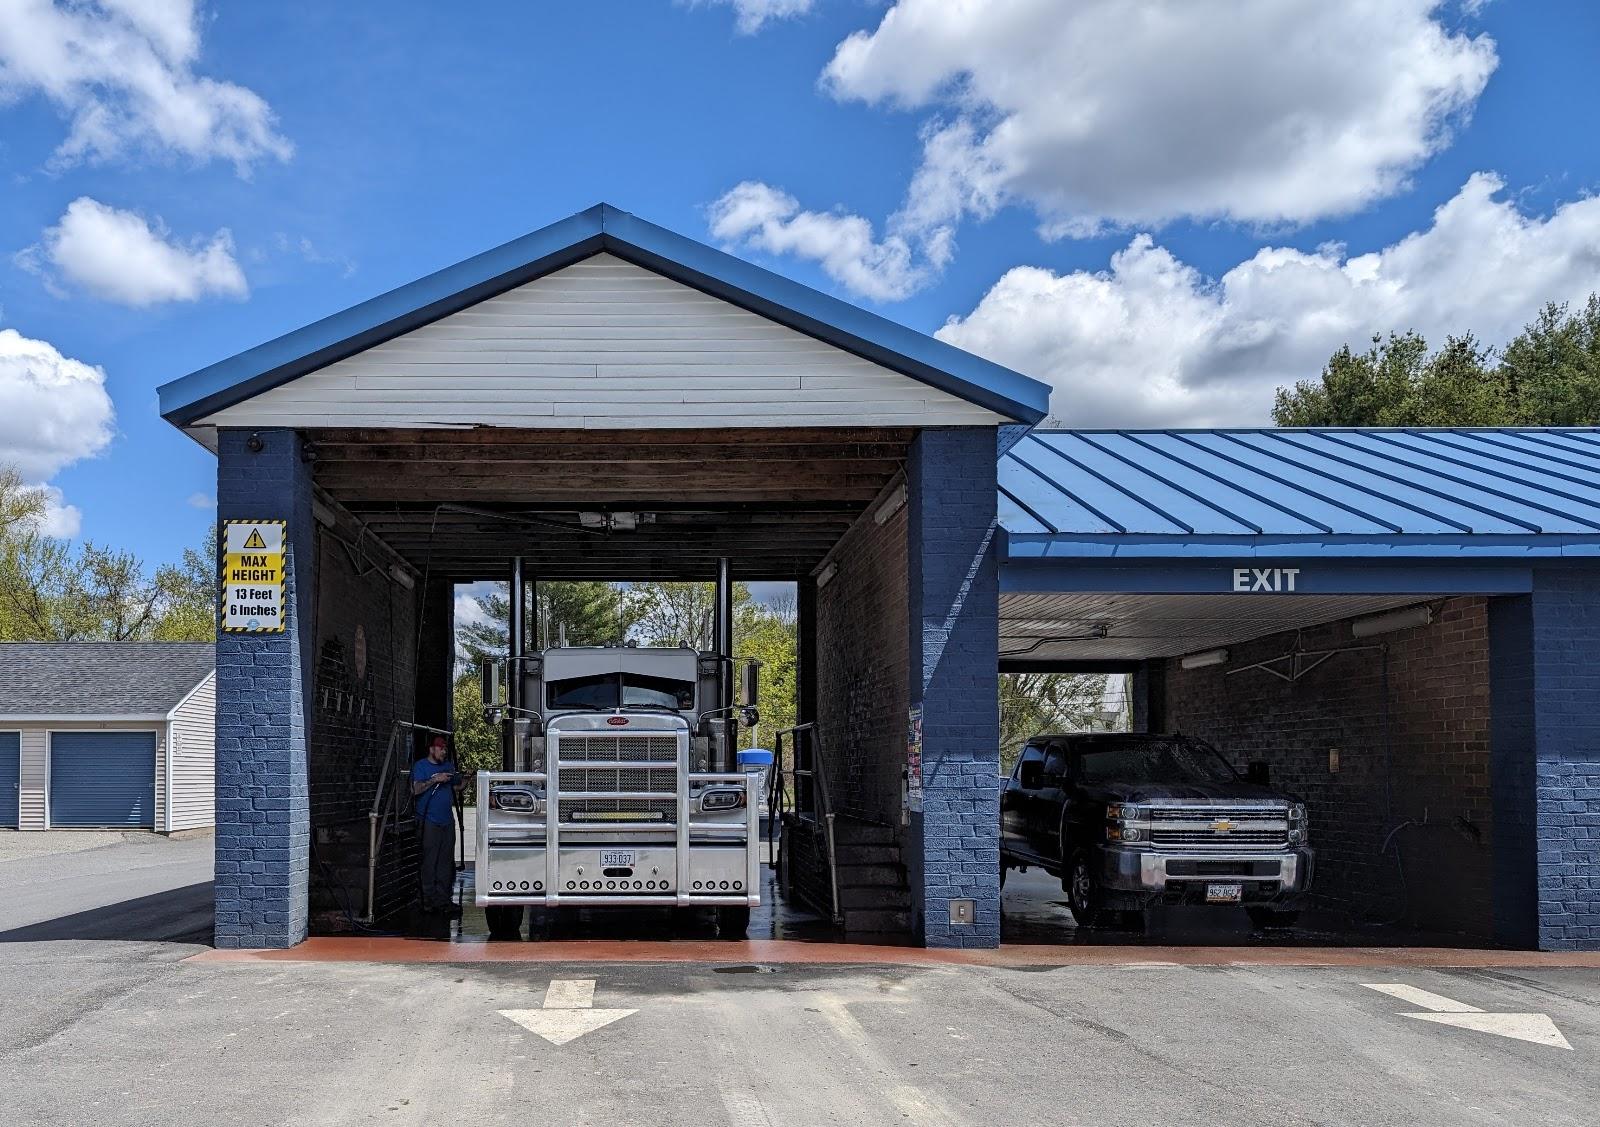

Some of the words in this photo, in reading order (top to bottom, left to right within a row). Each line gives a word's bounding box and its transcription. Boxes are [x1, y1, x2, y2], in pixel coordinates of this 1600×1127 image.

[241, 555, 268, 567] MAX
[232, 569, 276, 581] HEIGHT
[1233, 568, 1300, 592] EXIT
[235, 588, 247, 600] 13
[249, 588, 273, 600] Feet
[230, 604, 237, 616] 6
[239, 604, 277, 616] Inches
